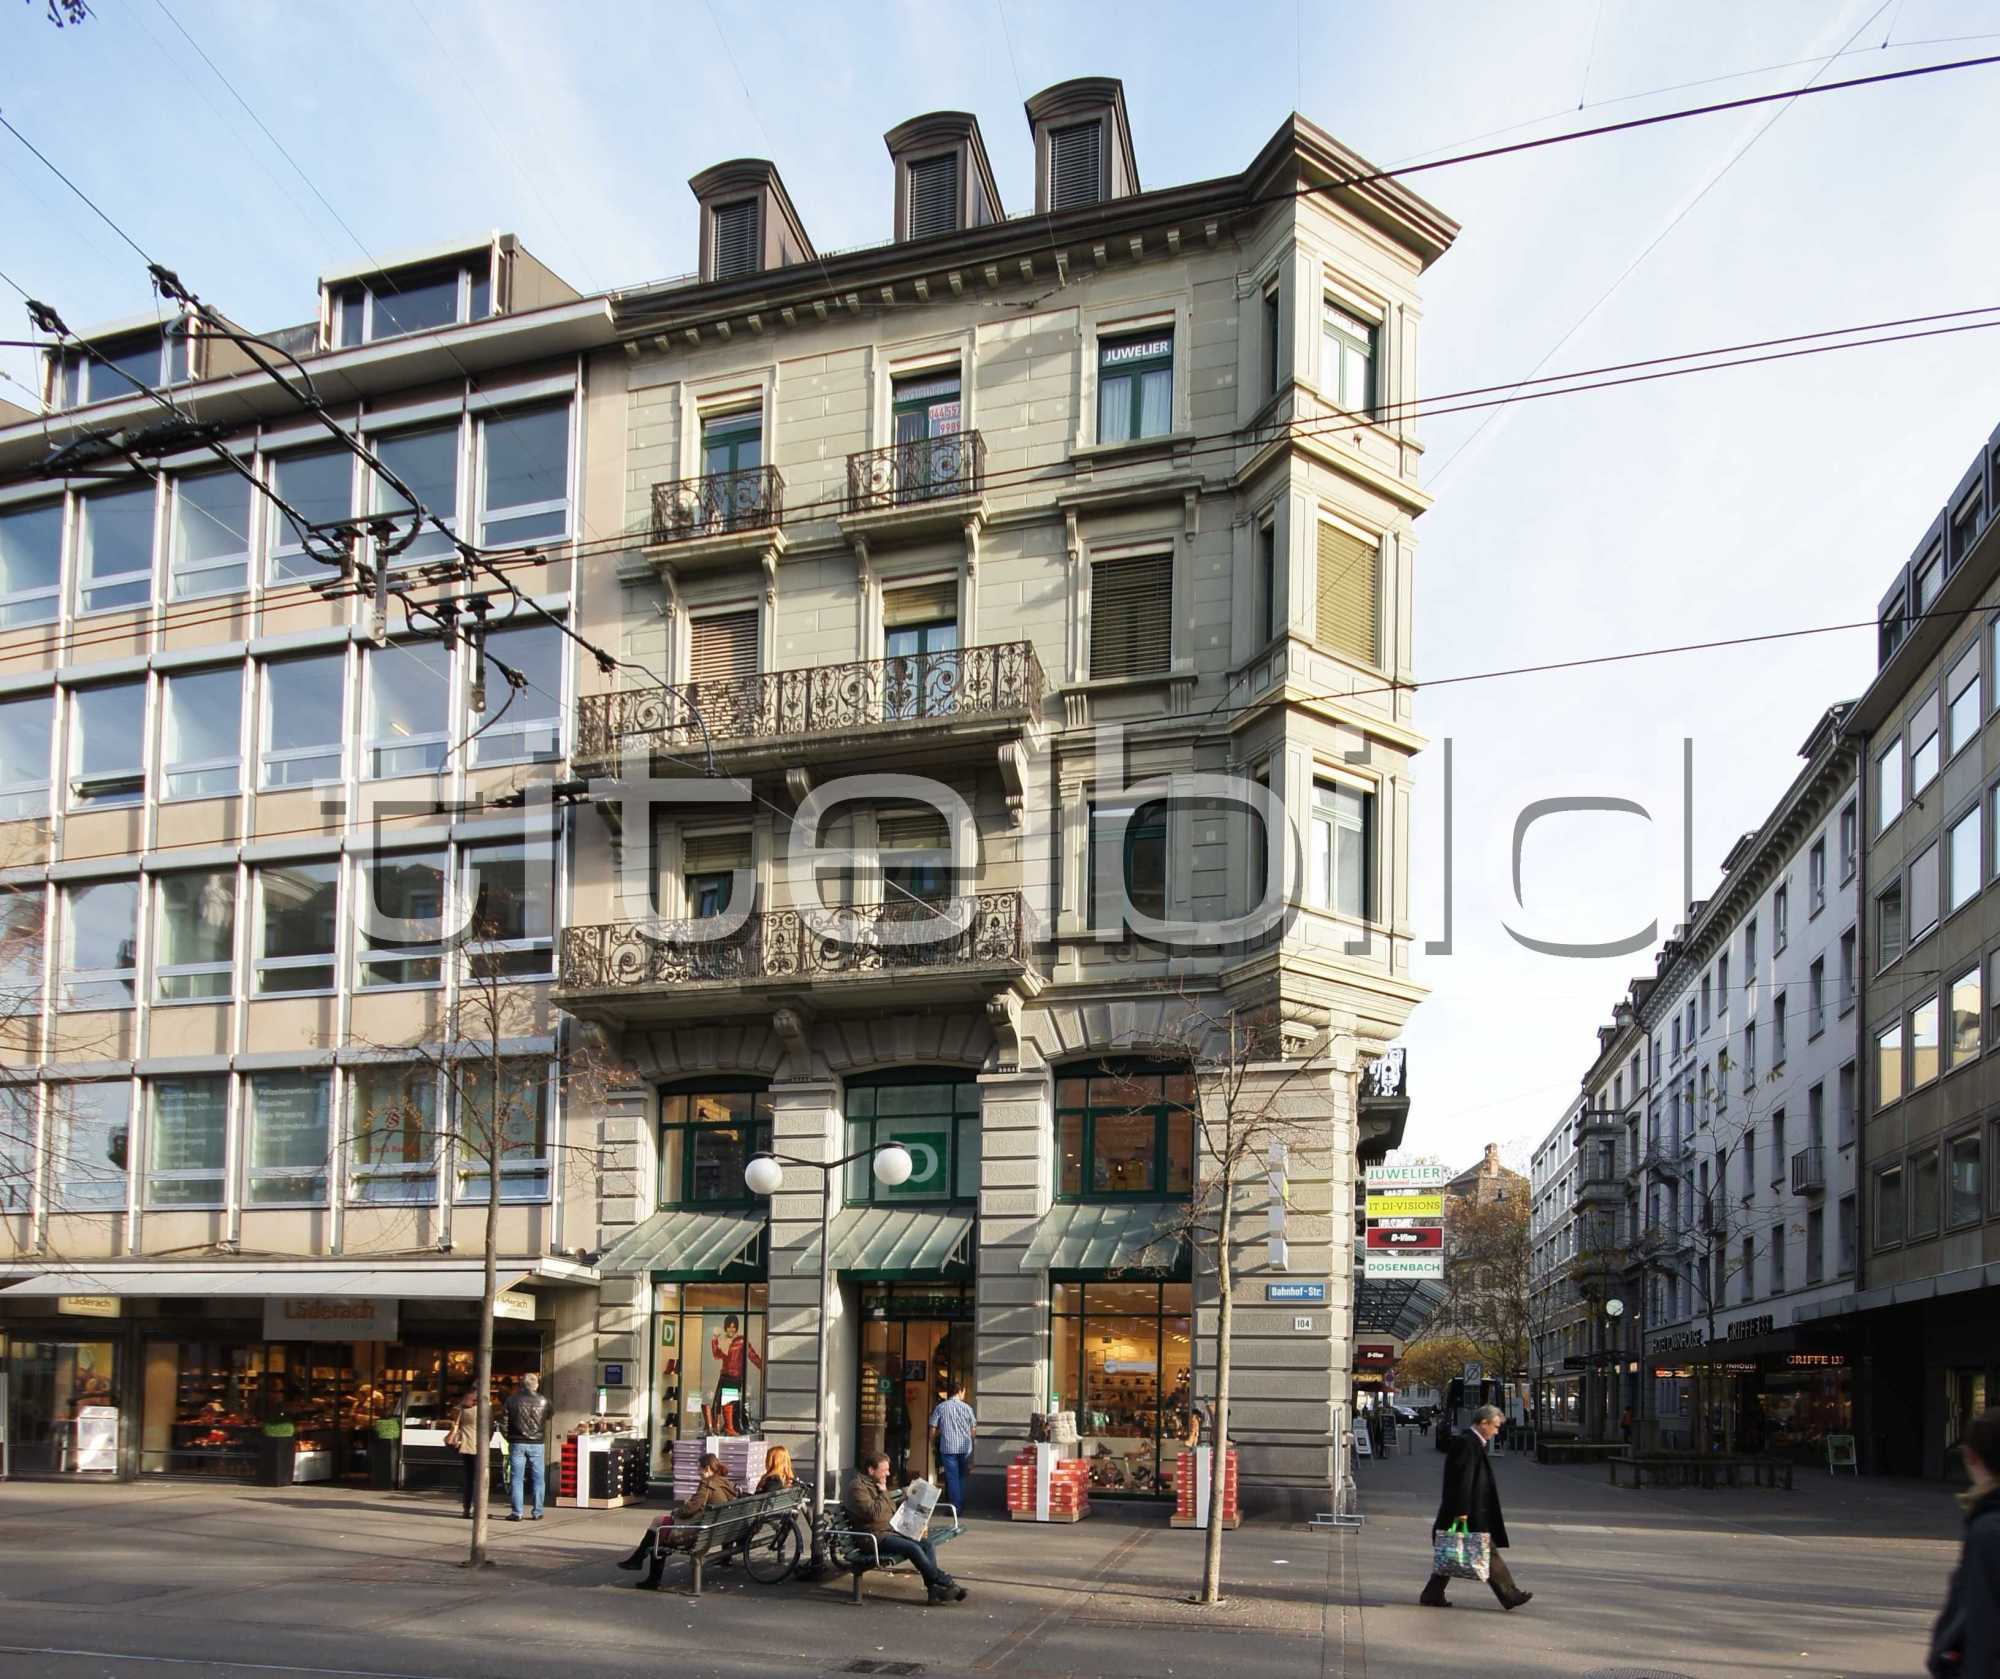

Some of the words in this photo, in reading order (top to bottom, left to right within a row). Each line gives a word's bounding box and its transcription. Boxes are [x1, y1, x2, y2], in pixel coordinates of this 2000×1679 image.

[1105, 340, 1169, 362] JUWELIER
[903, 1142, 938, 1183] D
[1368, 1167, 1441, 1180] JUWELIER
[1369, 1202, 1380, 1211] IT
[1368, 1263, 1441, 1272] DOSENBACH
[1297, 1319, 1310, 1328] 104
[664, 1324, 673, 1342] D
[1786, 1355, 1828, 1365] GRIFFE
[881, 1379, 890, 1389] D
